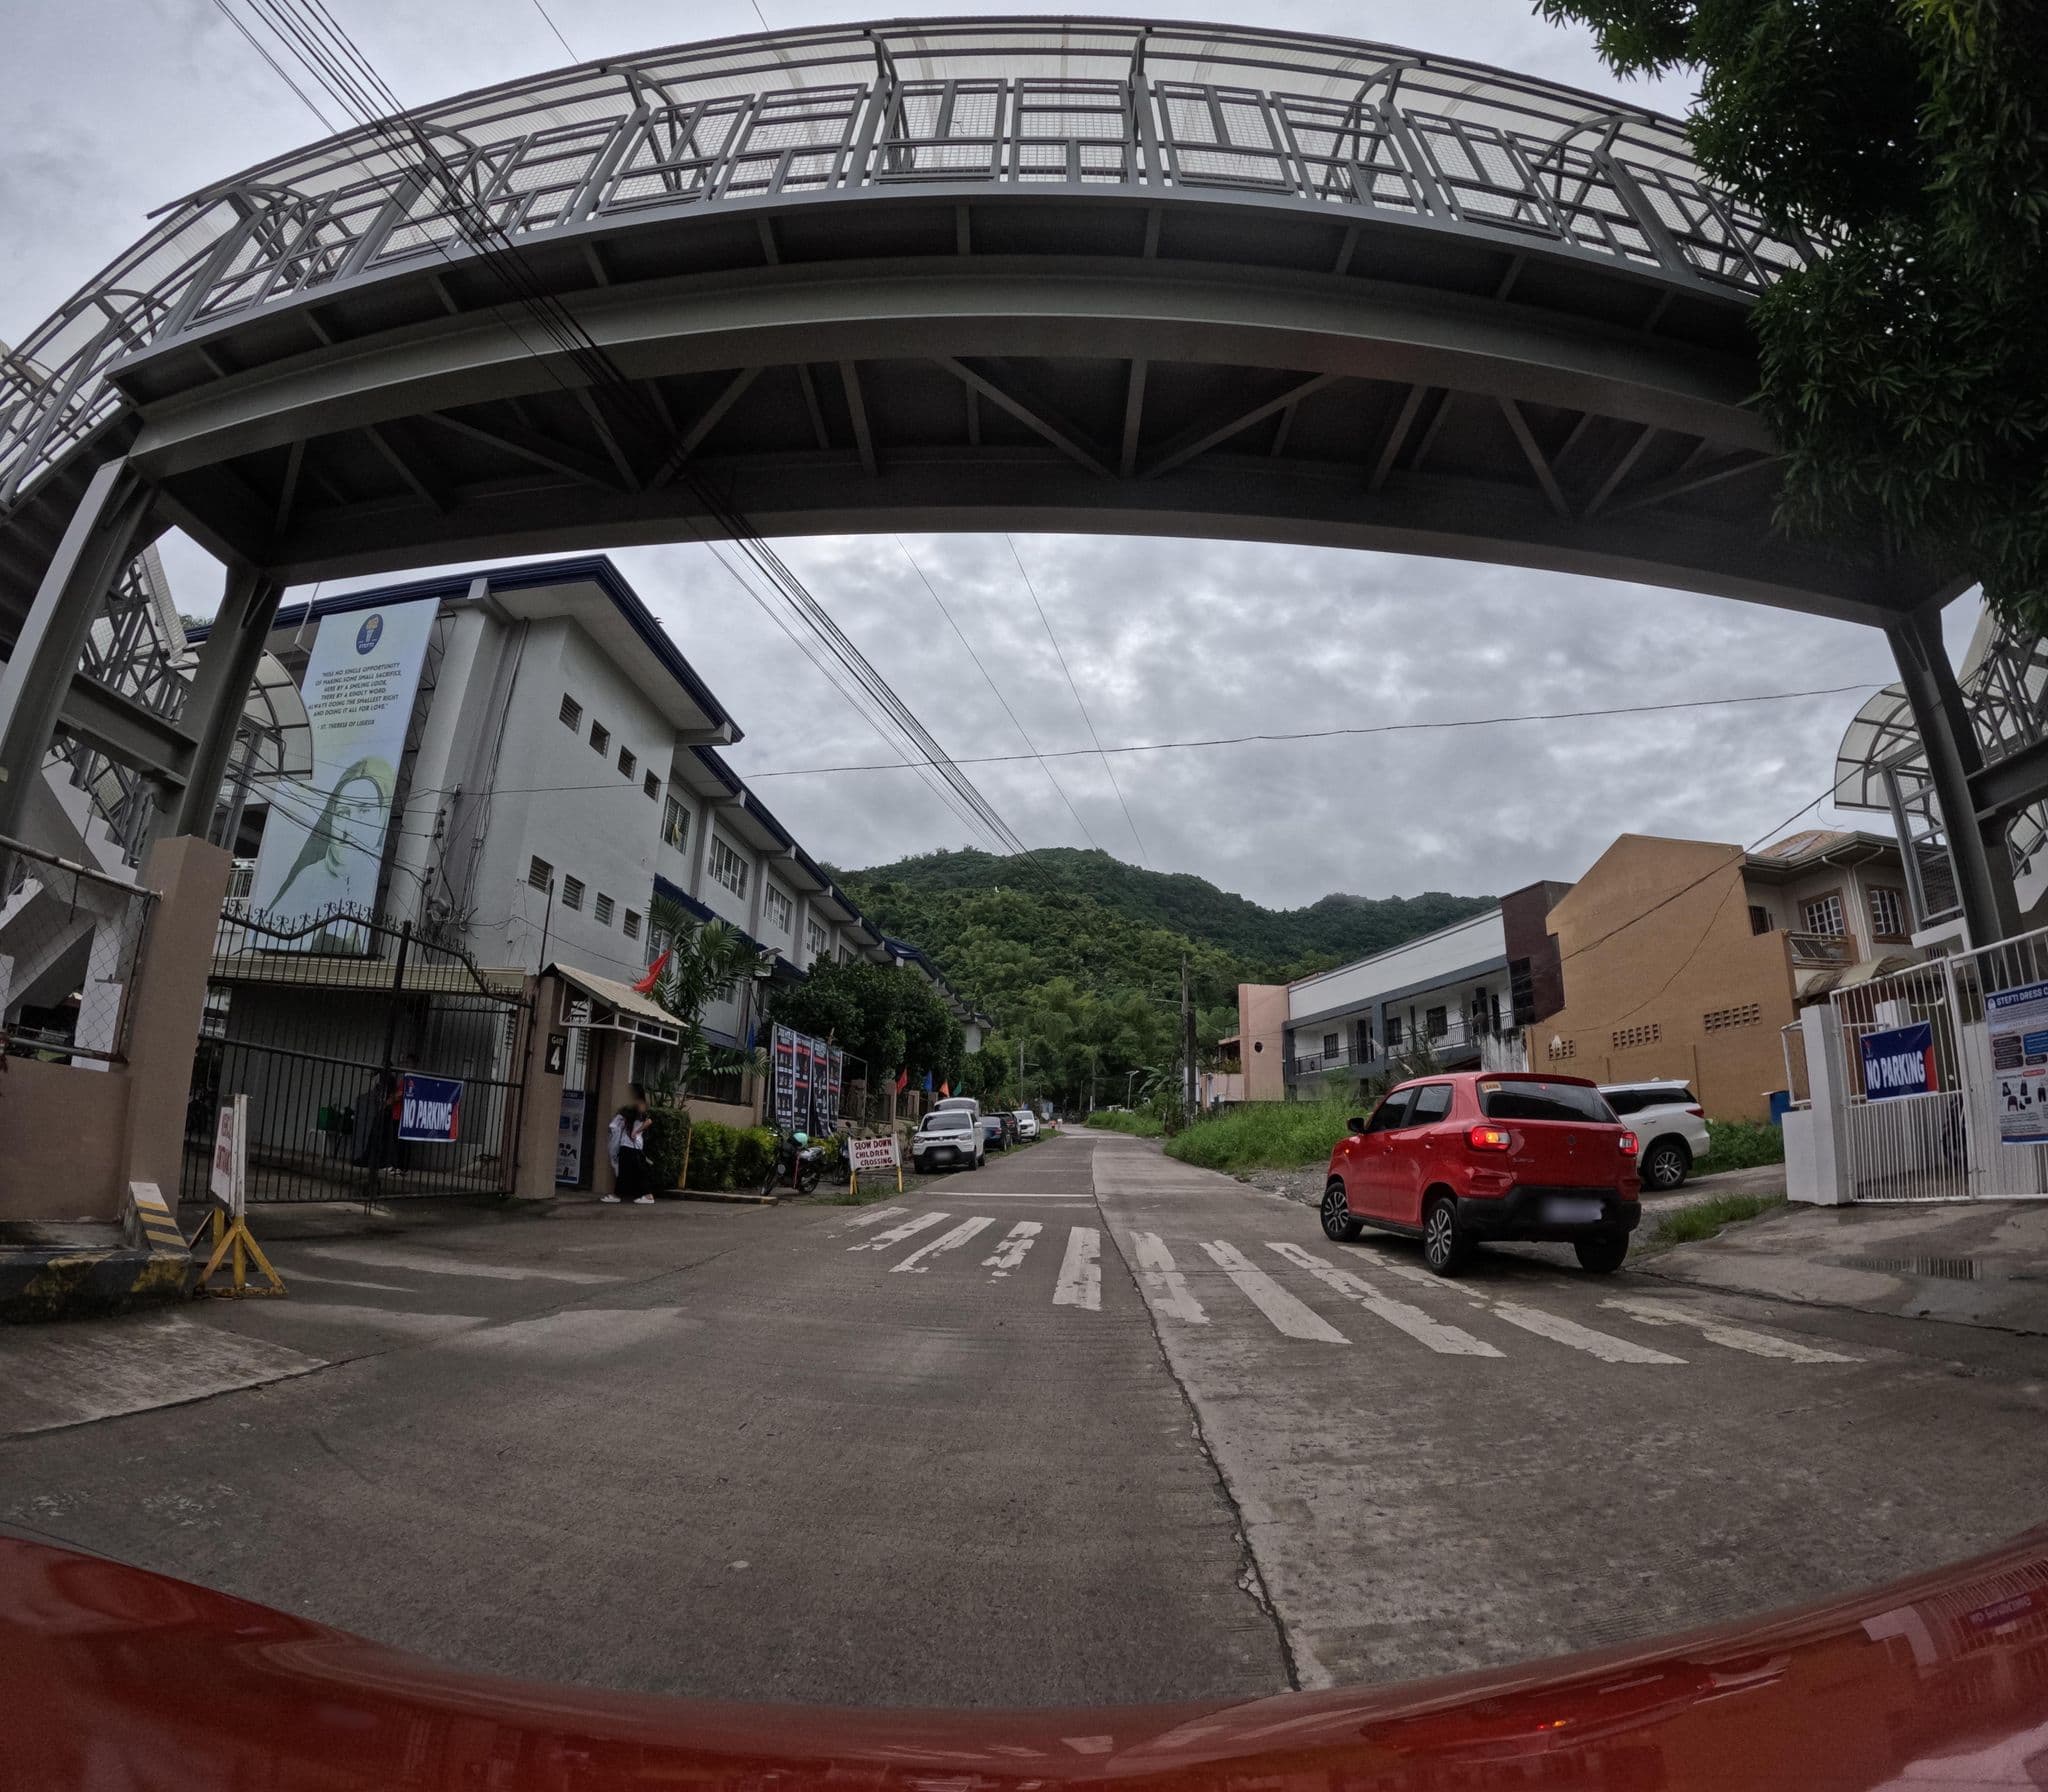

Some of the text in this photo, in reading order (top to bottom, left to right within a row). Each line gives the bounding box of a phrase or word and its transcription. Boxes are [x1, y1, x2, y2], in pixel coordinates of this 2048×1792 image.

[362, 662, 400, 673] OPPORTUNITY
[2019, 988, 2043, 1001] DRESS
[551, 1046, 560, 1070] 4
[1866, 1050, 1925, 1090] NO PARKING
[403, 1098, 452, 1131] NO PARKING
[854, 1139, 892, 1150] SLOW DOWN
[856, 1149, 889, 1158] CHILDREN
[860, 1157, 892, 1166] CROSSING
